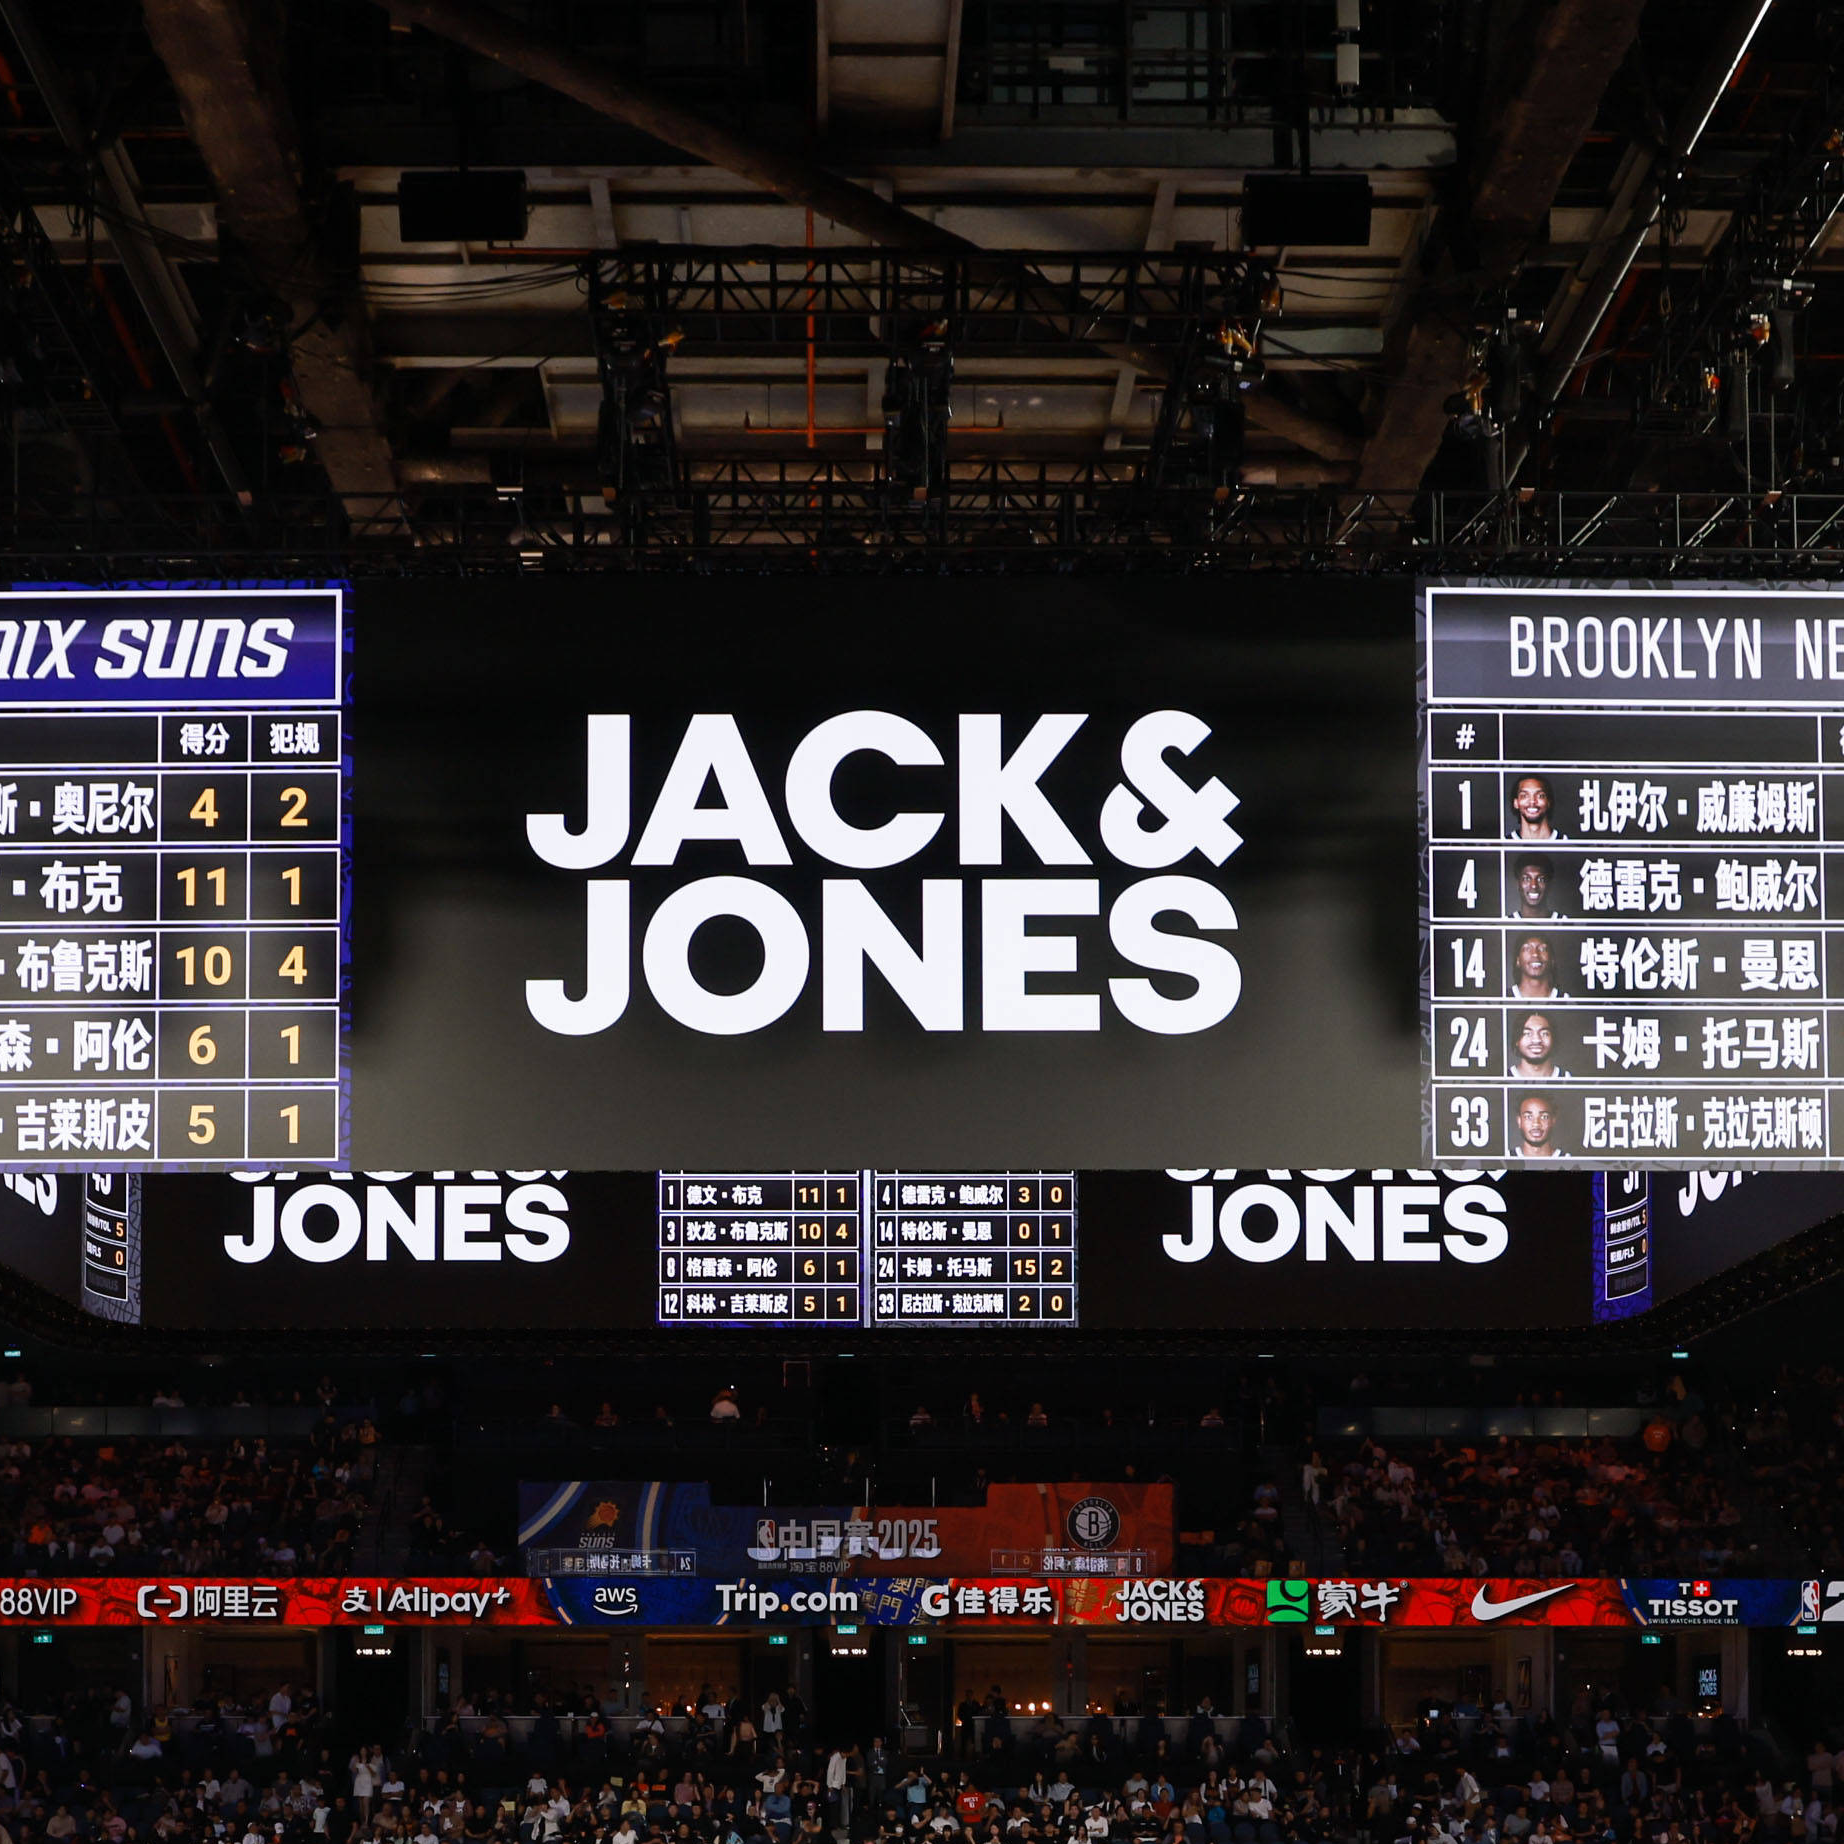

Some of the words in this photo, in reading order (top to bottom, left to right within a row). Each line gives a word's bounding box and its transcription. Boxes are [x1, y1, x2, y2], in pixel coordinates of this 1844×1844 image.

[95, 619, 294, 678] SUNS
[1511, 617, 1761, 679] BROOKLYN
[180, 723, 229, 754] 得分
[270, 723, 319, 754] 犯规
[1456, 724, 1475, 749] #
[190, 789, 218, 826] 4
[281, 788, 307, 826] 2
[527, 710, 1243, 869] JACK&
[1459, 781, 1470, 829] 1
[178, 868, 225, 906] 11
[282, 867, 300, 905] 1
[1458, 860, 1477, 908] 4
[177, 946, 231, 985] 10
[279, 946, 307, 984] 4
[526, 876, 1241, 1035] JONES
[1451, 939, 1485, 987] 14
[189, 1026, 216, 1064] 6
[281, 1026, 299, 1063] 1
[1451, 1017, 1488, 1067] 24
[189, 1105, 215, 1144] 5
[281, 1105, 298, 1143] 1
[1451, 1097, 1489, 1147] 33
[668, 1186, 673, 1205] 1
[799, 1188, 818, 1203] 11
[837, 1188, 844, 1203] 1
[883, 1185, 890, 1205] 4
[1019, 1187, 1029, 1202] 3
[1051, 1187, 1062, 1202] 0
[224, 1184, 569, 1263] JONES
[667, 1221, 675, 1241] 3
[799, 1224, 821, 1239] 10
[836, 1224, 847, 1239] 4
[880, 1221, 893, 1241] 14
[1019, 1223, 1030, 1239] 0
[1052, 1224, 1059, 1238] 1
[1163, 1184, 1508, 1263] JONES
[667, 1258, 675, 1277] 8
[804, 1260, 815, 1275] 6
[837, 1260, 844, 1275] 1
[879, 1258, 894, 1277] 24
[1014, 1260, 1036, 1275] 15
[1051, 1260, 1062, 1275] 2
[665, 1294, 677, 1313] 12
[804, 1296, 815, 1312] 5
[837, 1296, 844, 1311] 1
[879, 1294, 894, 1313] 33
[1019, 1296, 1030, 1311] 2
[1052, 1296, 1062, 1311] 0
[193, 1586, 278, 1618] 阿里云
[595, 1586, 637, 1604] aws
[715, 1585, 857, 1618] Trip.com
[955, 1586, 1052, 1615] 佳得乐
[1116, 1580, 1205, 1600] JACK&
[1317, 1581, 1400, 1622] 蒙牛
[1116, 1601, 1205, 1621] JONES
[1648, 1600, 1738, 1616] TISSOT
